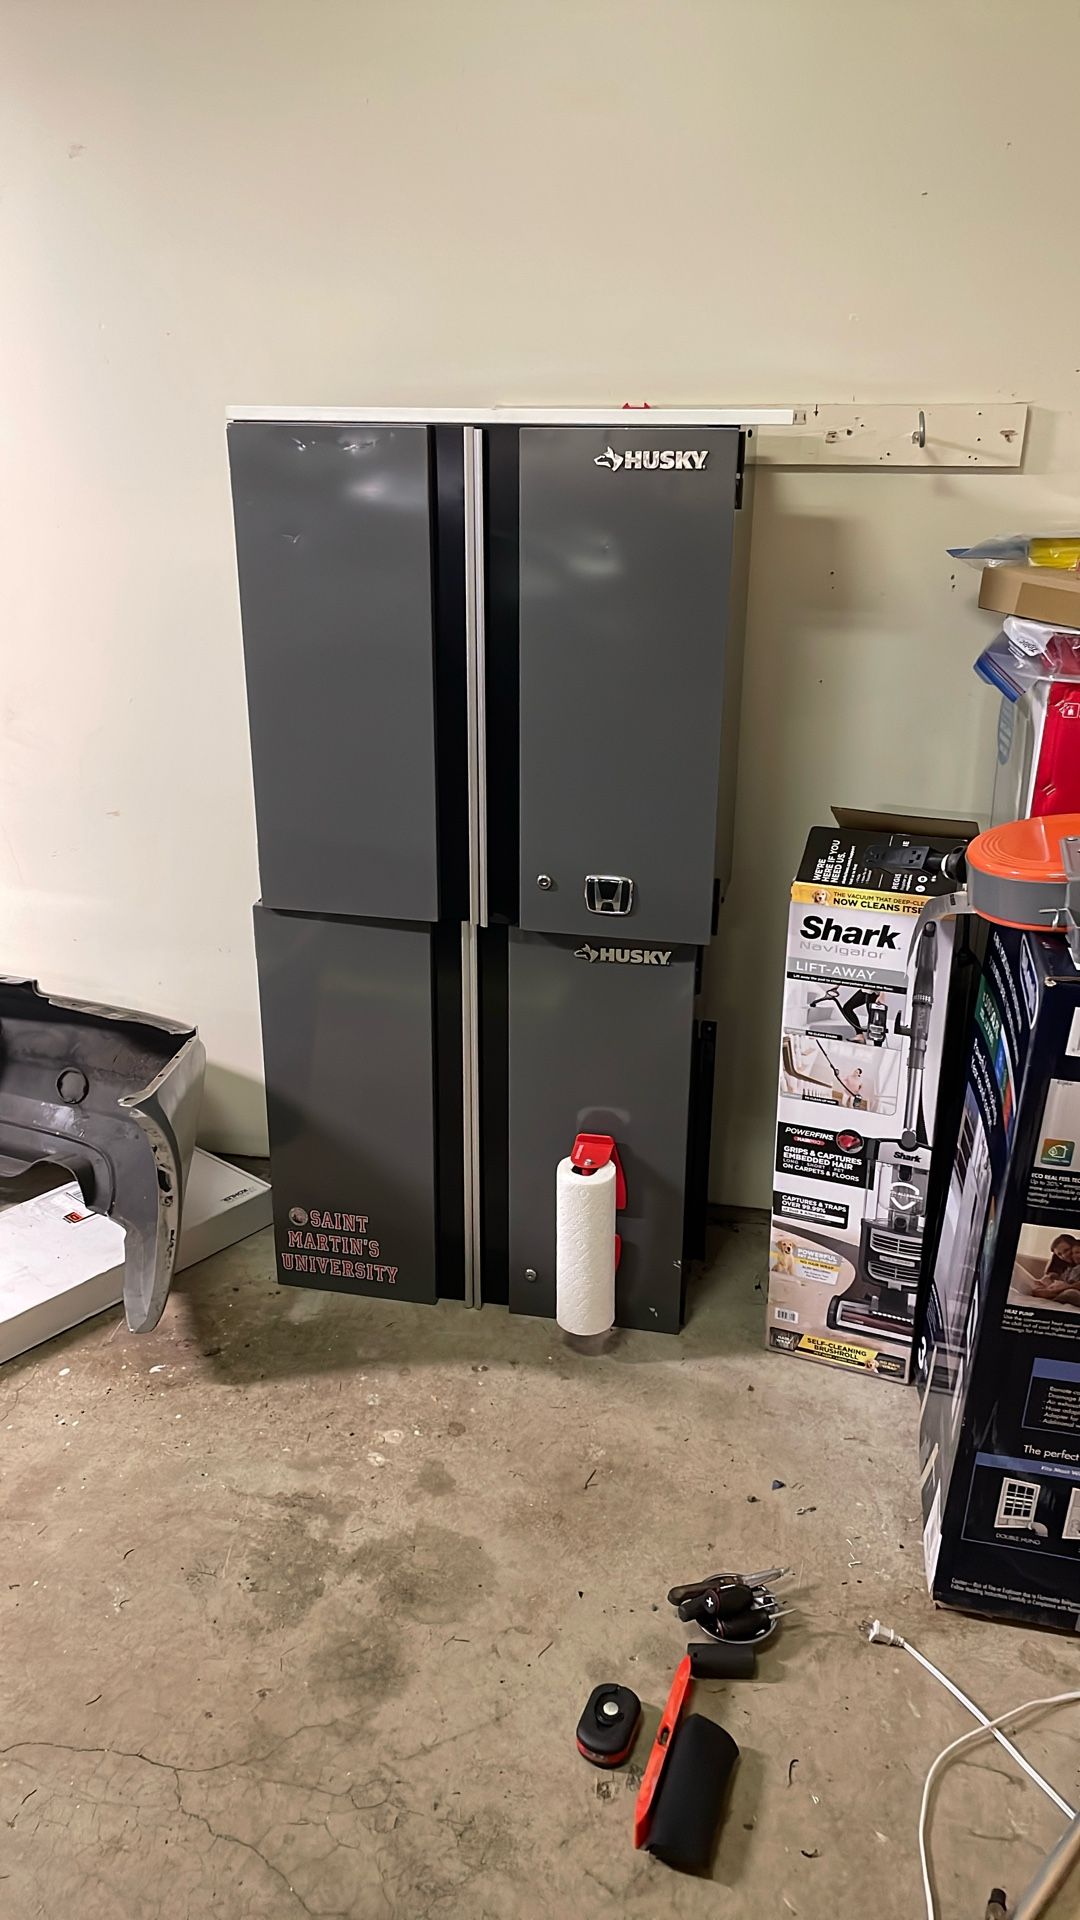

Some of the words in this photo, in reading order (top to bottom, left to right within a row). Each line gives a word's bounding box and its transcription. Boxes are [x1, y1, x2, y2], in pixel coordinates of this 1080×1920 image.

[624, 450, 709, 469] HUSKY
[813, 858, 826, 880] WE'RE
[821, 864, 834, 882] HERE
[829, 840, 840, 854] YOU
[830, 864, 842, 883] NEED
[836, 852, 846, 864] US.
[891, 874, 902, 890] REGIS
[833, 898, 858, 906] NOW
[860, 901, 900, 912] CLEANS
[902, 906, 924, 914] ITSE
[800, 915, 901, 950] Shark
[600, 948, 672, 966] HUSKY
[800, 941, 884, 960] Navigator
[796, 961, 876, 980] LIFT-AWAY
[784, 1127, 834, 1140] POWERFINS
[783, 1152, 830, 1166] EMBEDDED
[832, 1161, 853, 1170] HAIR
[784, 1146, 808, 1155] GRIPS
[817, 1152, 862, 1166] CAPTURES
[894, 1152, 922, 1163] Shark
[794, 1165, 825, 1175] CARPETS
[832, 1172, 859, 1182] FLOORS
[782, 1195, 817, 1206] CAPTURES
[824, 1203, 846, 1212] TRAPS
[782, 1200, 800, 1208] OVER
[309, 1210, 368, 1233] SAINT
[288, 1230, 380, 1258] MARTIN'S
[282, 1252, 398, 1284] UNIVERSITY
[807, 1338, 867, 1357] SELF-CLEANING
[814, 1345, 859, 1360] BRUSHROLL
[1024, 1444, 1041, 1456] The
[1044, 1450, 1080, 1461] perfect
